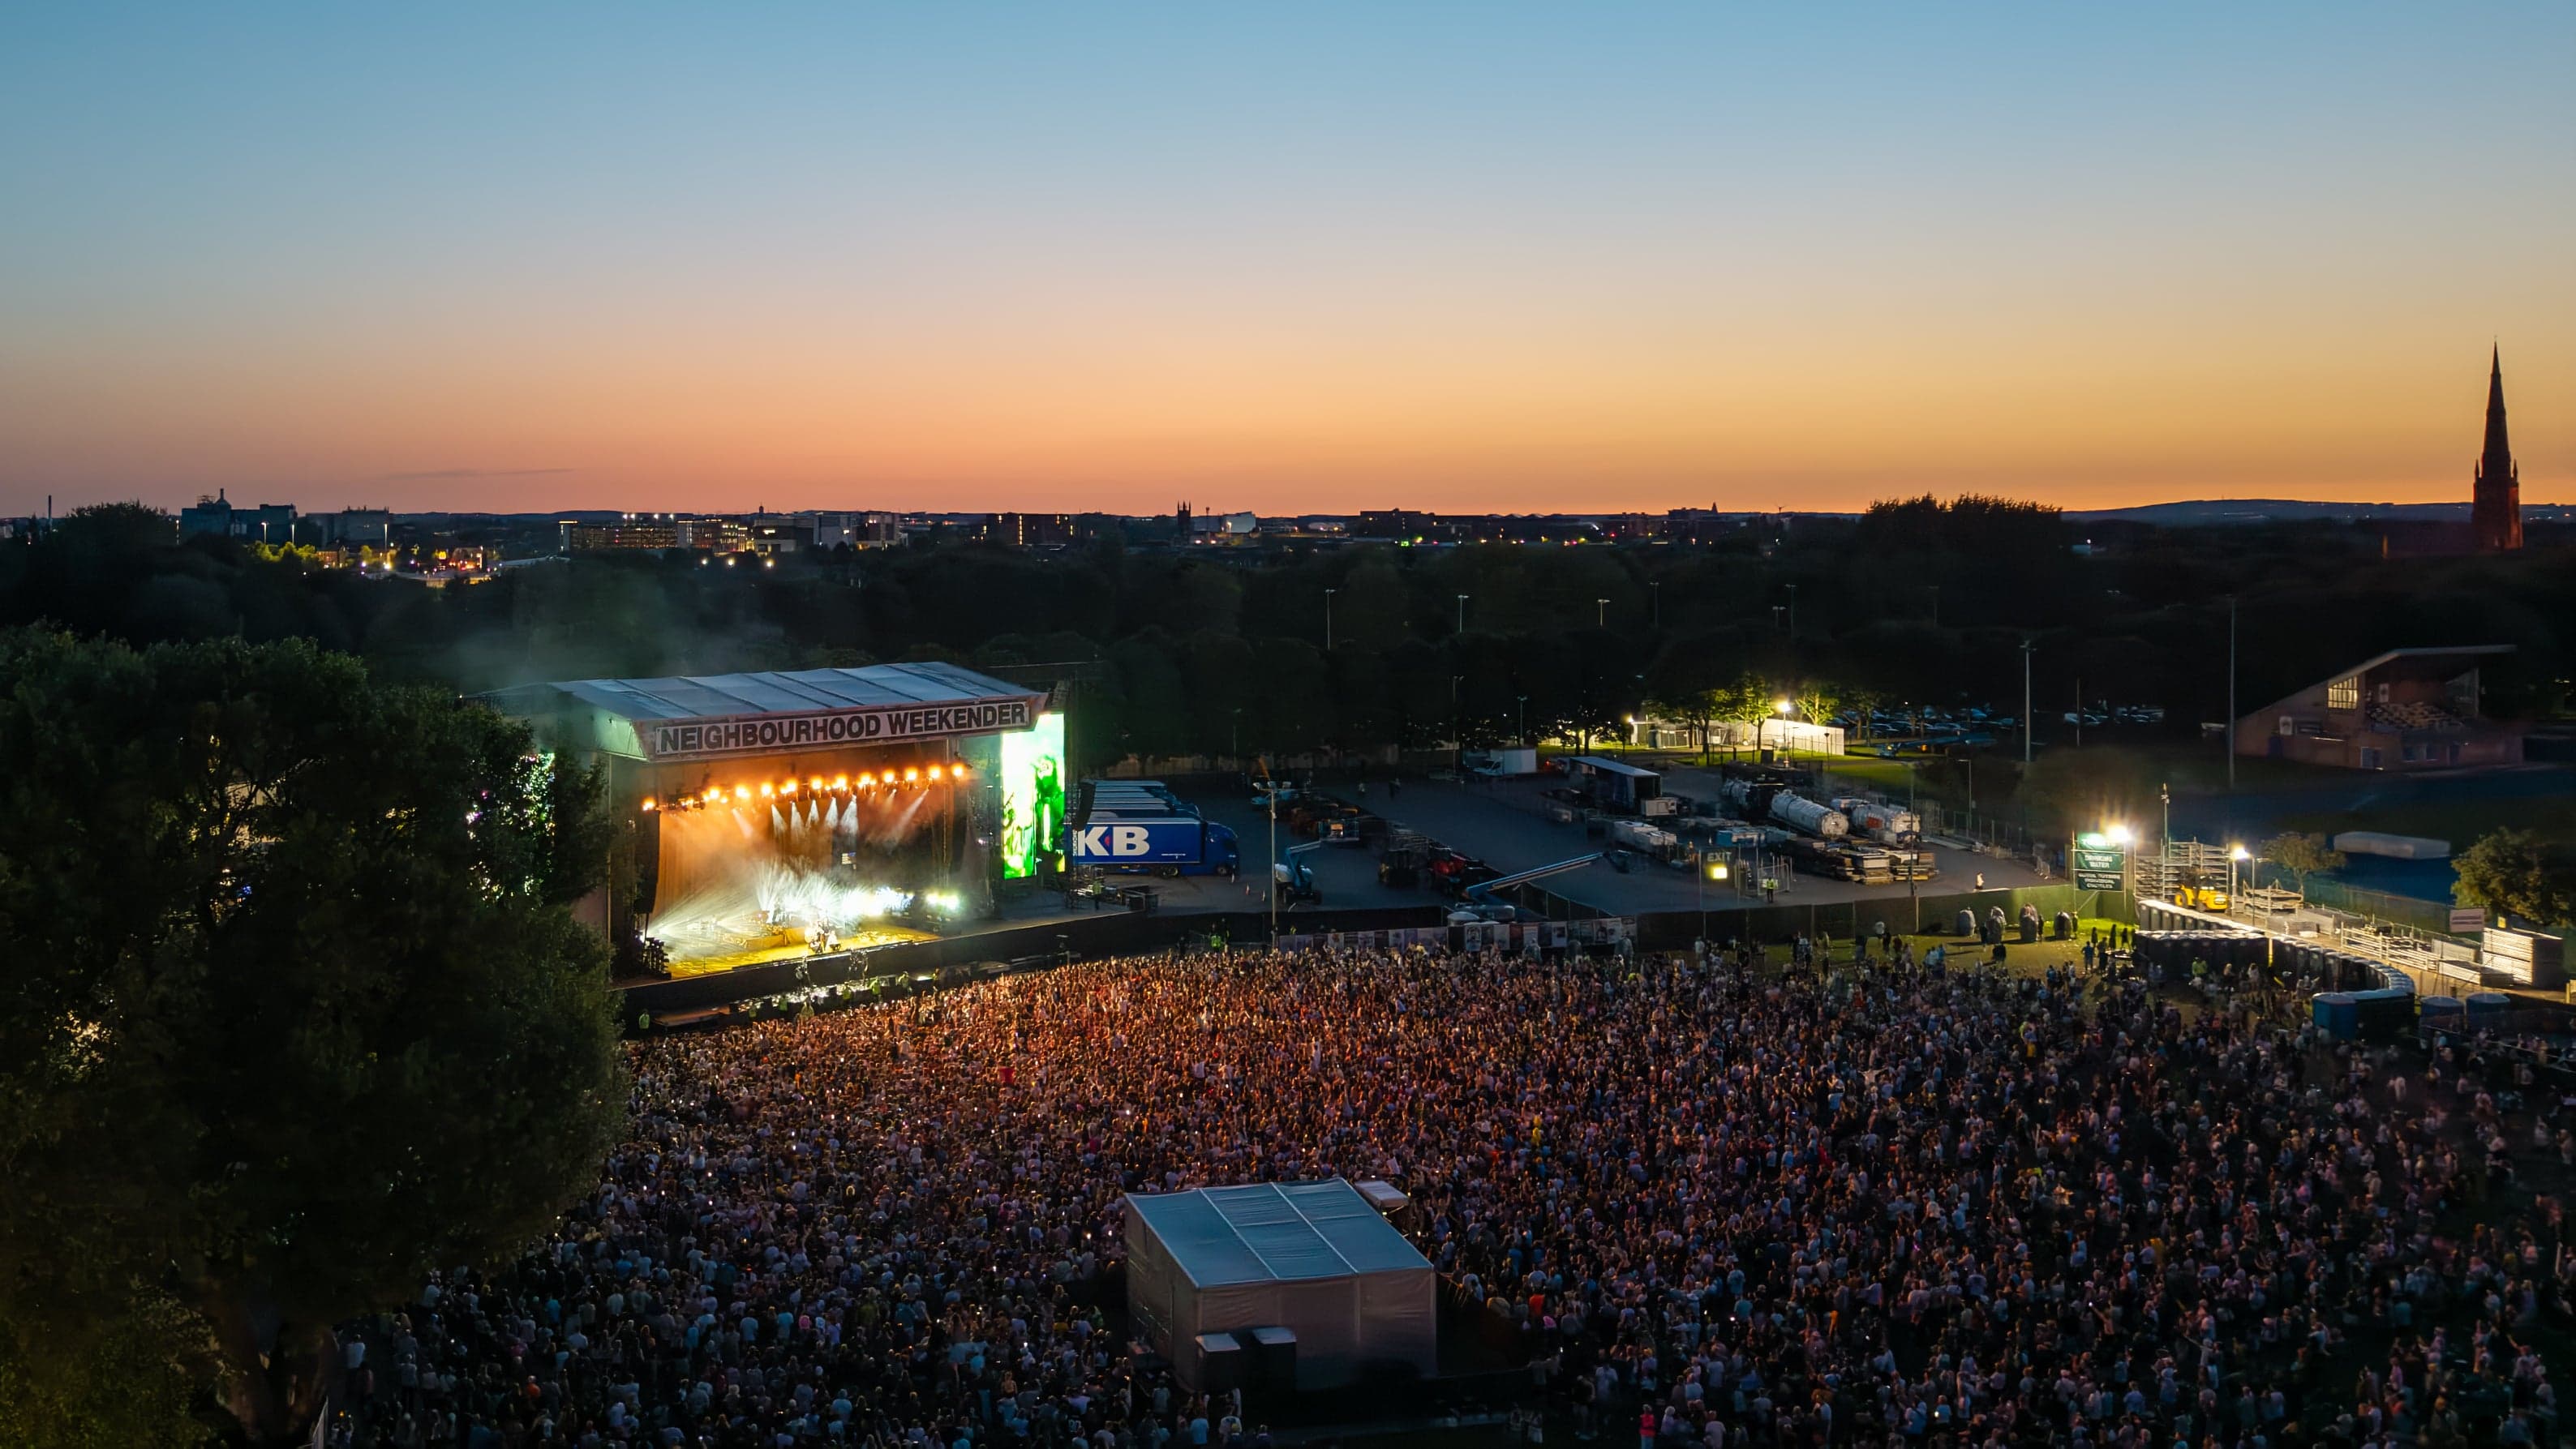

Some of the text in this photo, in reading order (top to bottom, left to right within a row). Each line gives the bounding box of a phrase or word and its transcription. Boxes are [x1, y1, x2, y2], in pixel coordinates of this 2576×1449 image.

[660, 703, 1026, 752] NEIGHBOURHOOD WEEKENDER
[1072, 826, 1150, 856] KB
[1707, 851, 1732, 862] EXIT
